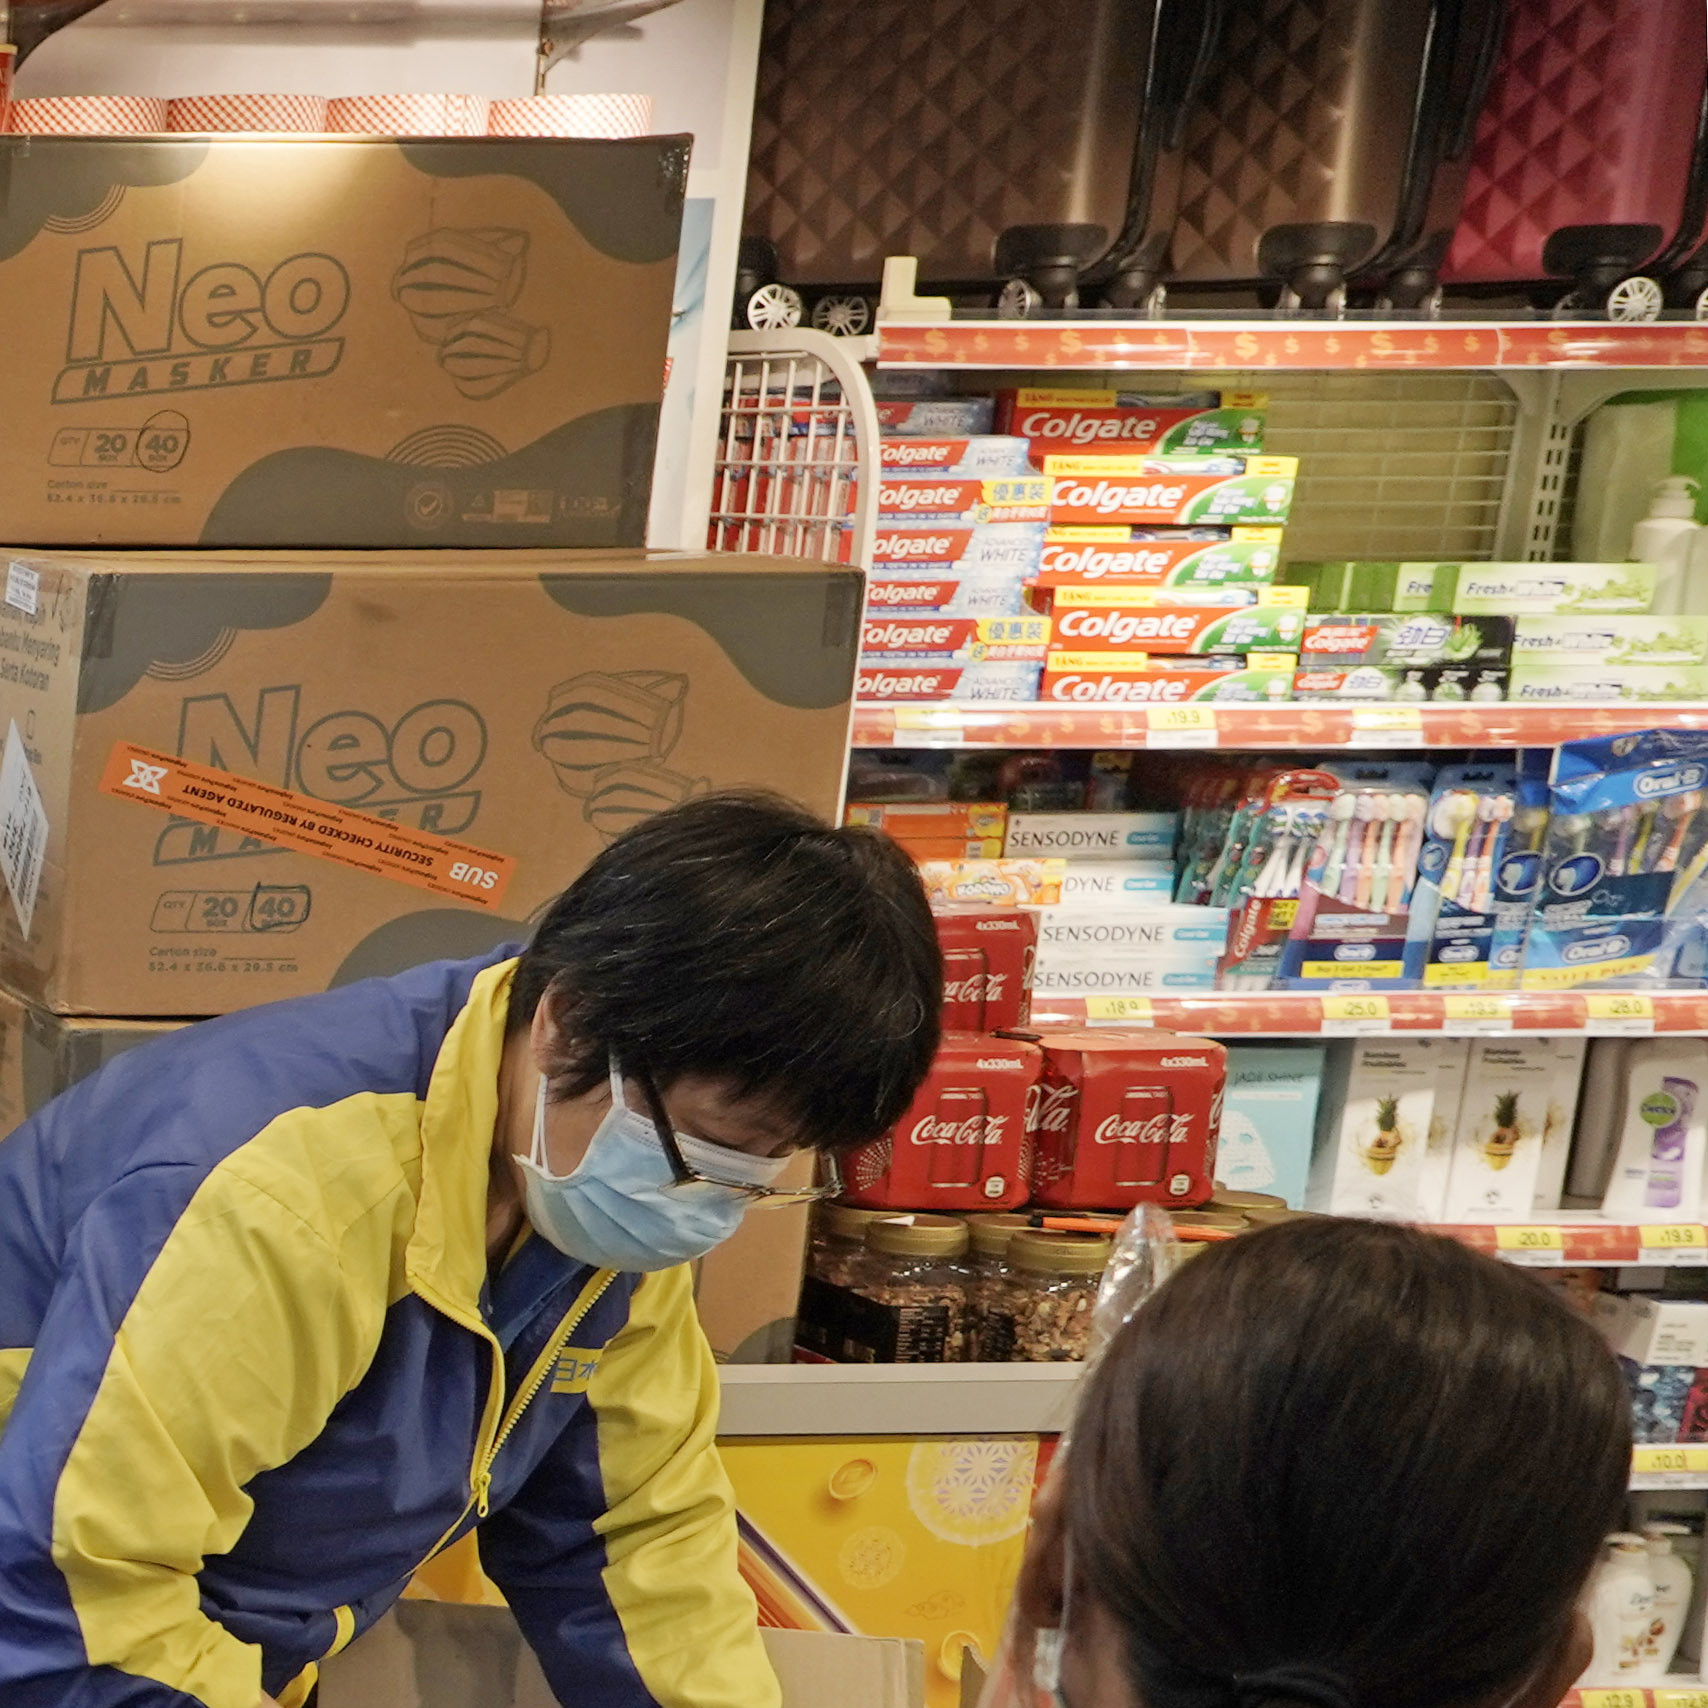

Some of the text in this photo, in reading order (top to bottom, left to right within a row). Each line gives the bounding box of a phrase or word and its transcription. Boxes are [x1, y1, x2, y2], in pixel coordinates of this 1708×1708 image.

[66, 237, 351, 364] Neo
[82, 349, 314, 396] MASKER
[1021, 409, 1159, 445] Colgate
[94, 433, 128, 454] 20
[145, 433, 179, 454] 40
[1051, 479, 1185, 514] Colgate
[980, 550, 1027, 562] WHITE
[1038, 546, 1172, 579] Colgate
[967, 594, 1009, 607] WHITE
[1058, 610, 1199, 645] Colgate
[1052, 676, 1187, 701] Colgate
[172, 684, 488, 822] Neo
[1637, 764, 1703, 795] Oral-B
[182, 784, 434, 868] SECURITY CHECKED BY REGULATED AGENT
[189, 802, 446, 857] MAER
[1008, 831, 1120, 848] SENSODYNE
[448, 860, 499, 891] SUB
[202, 897, 237, 919] 20
[258, 897, 296, 919] 40
[1041, 925, 1166, 943] SENSODYNE
[1234, 898, 1264, 961] Colgate
[149, 947, 217, 958] Carton size
[1032, 971, 1155, 988] SENSODYNE
[975, 1057, 1025, 1071] 4x330mL
[1159, 1055, 1209, 1068] 4x330mL
[910, 1114, 1010, 1146] Coca-Cola
[1094, 1113, 1197, 1146] Coca-Cola
